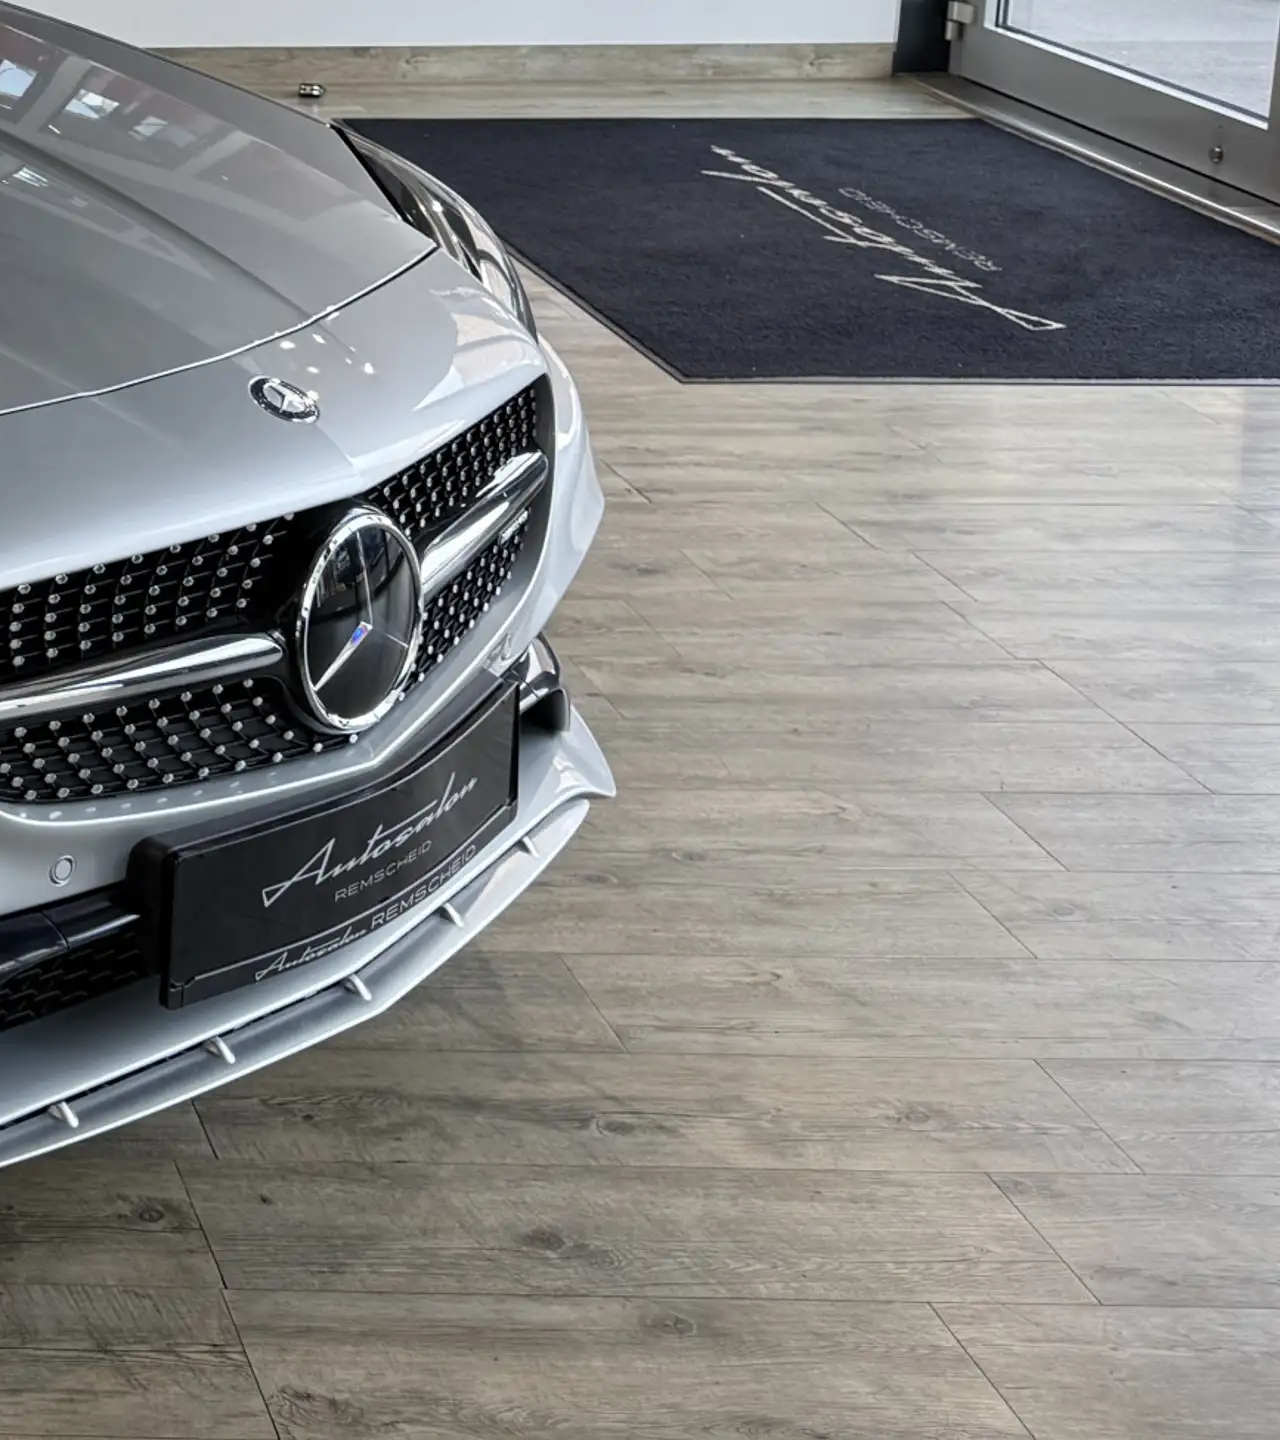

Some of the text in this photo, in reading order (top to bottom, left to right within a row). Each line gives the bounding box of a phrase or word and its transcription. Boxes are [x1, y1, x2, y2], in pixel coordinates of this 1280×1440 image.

[261, 771, 478, 908] Autosalon
[334, 839, 433, 903] REMSCHEID
[255, 844, 477, 982] Autosalon REMSCHEID
